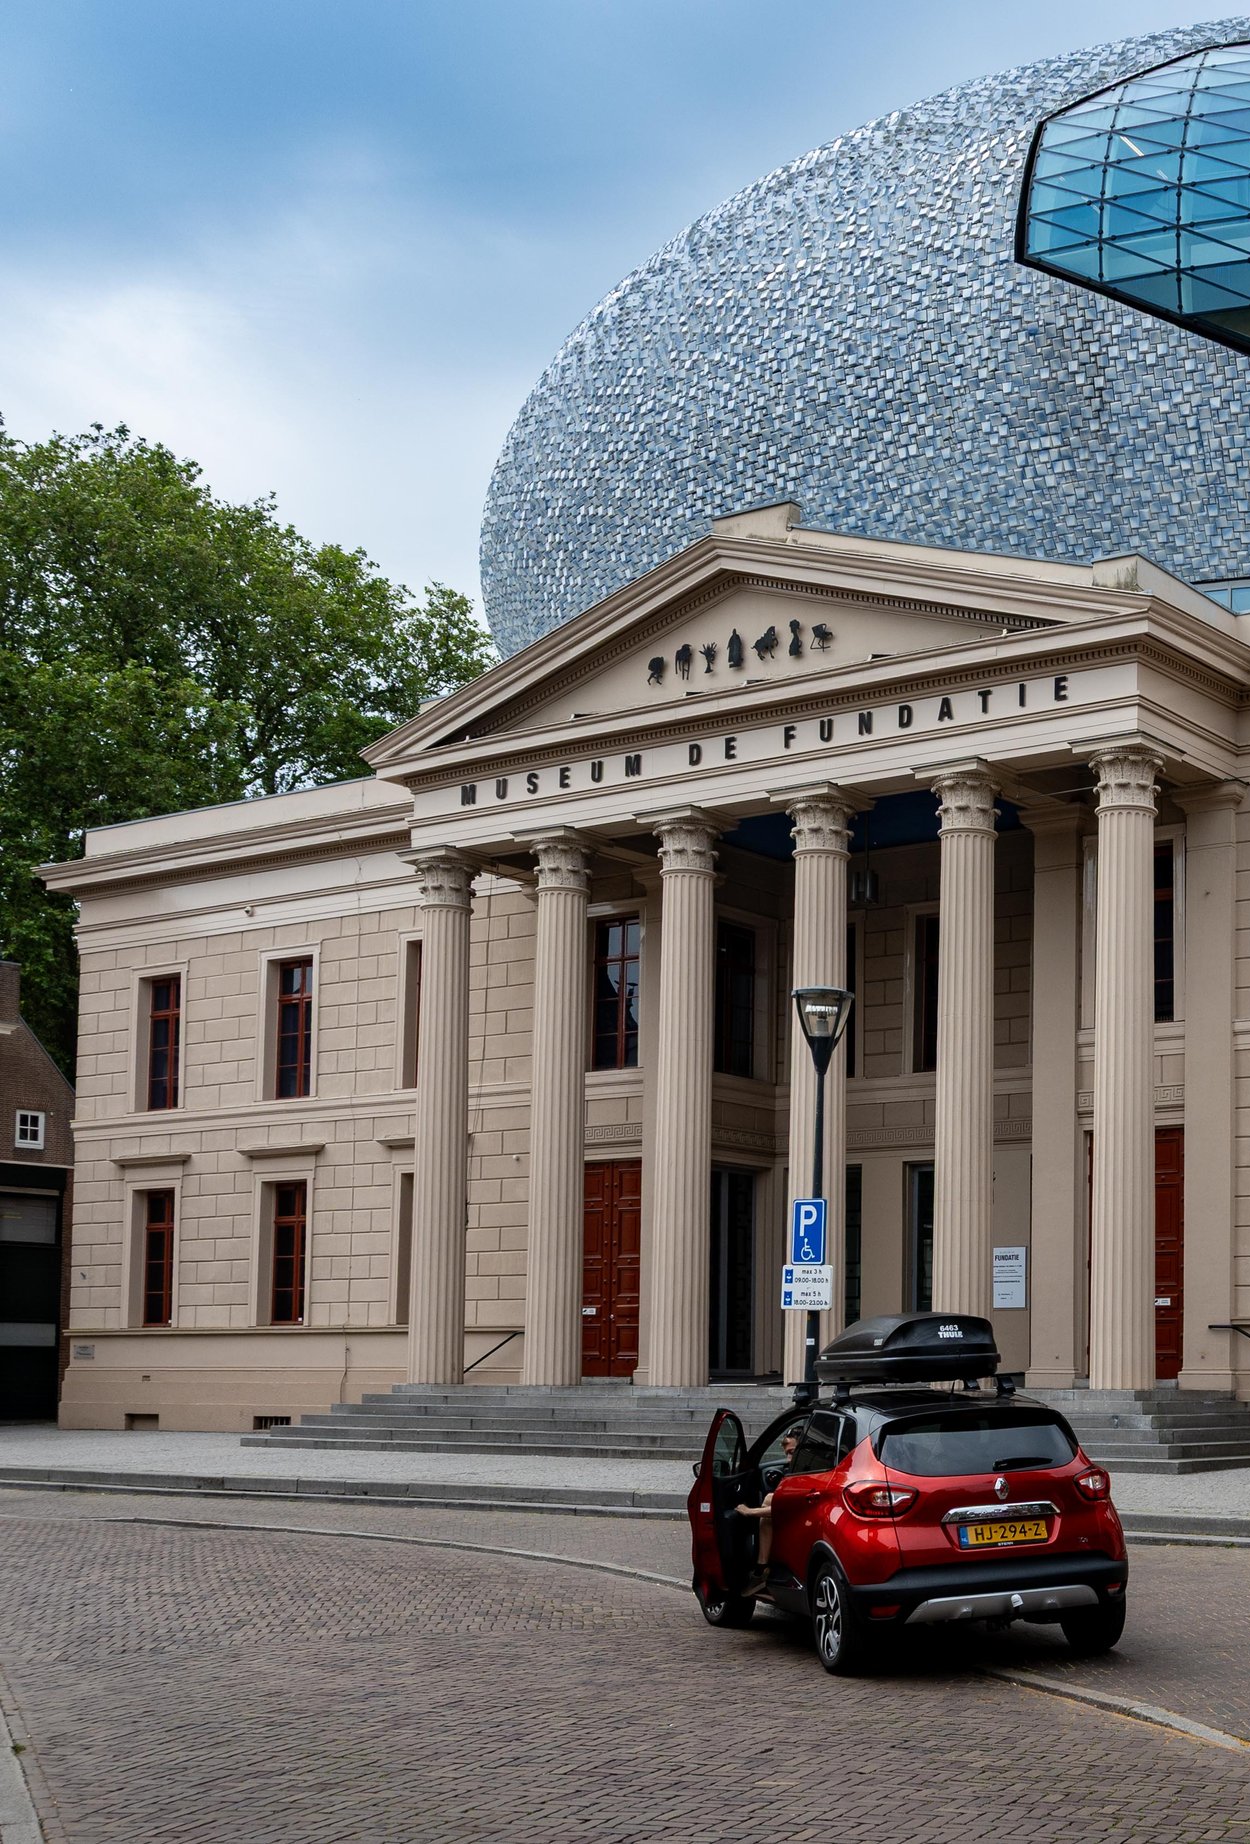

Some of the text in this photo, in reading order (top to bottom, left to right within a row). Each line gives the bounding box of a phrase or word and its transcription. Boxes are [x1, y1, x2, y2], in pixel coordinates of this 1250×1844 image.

[461, 676, 1069, 806] MUSEUM DE FUNDATIE
[800, 1205, 818, 1237] P
[975, 1523, 1042, 1541] HJ-294-Z
